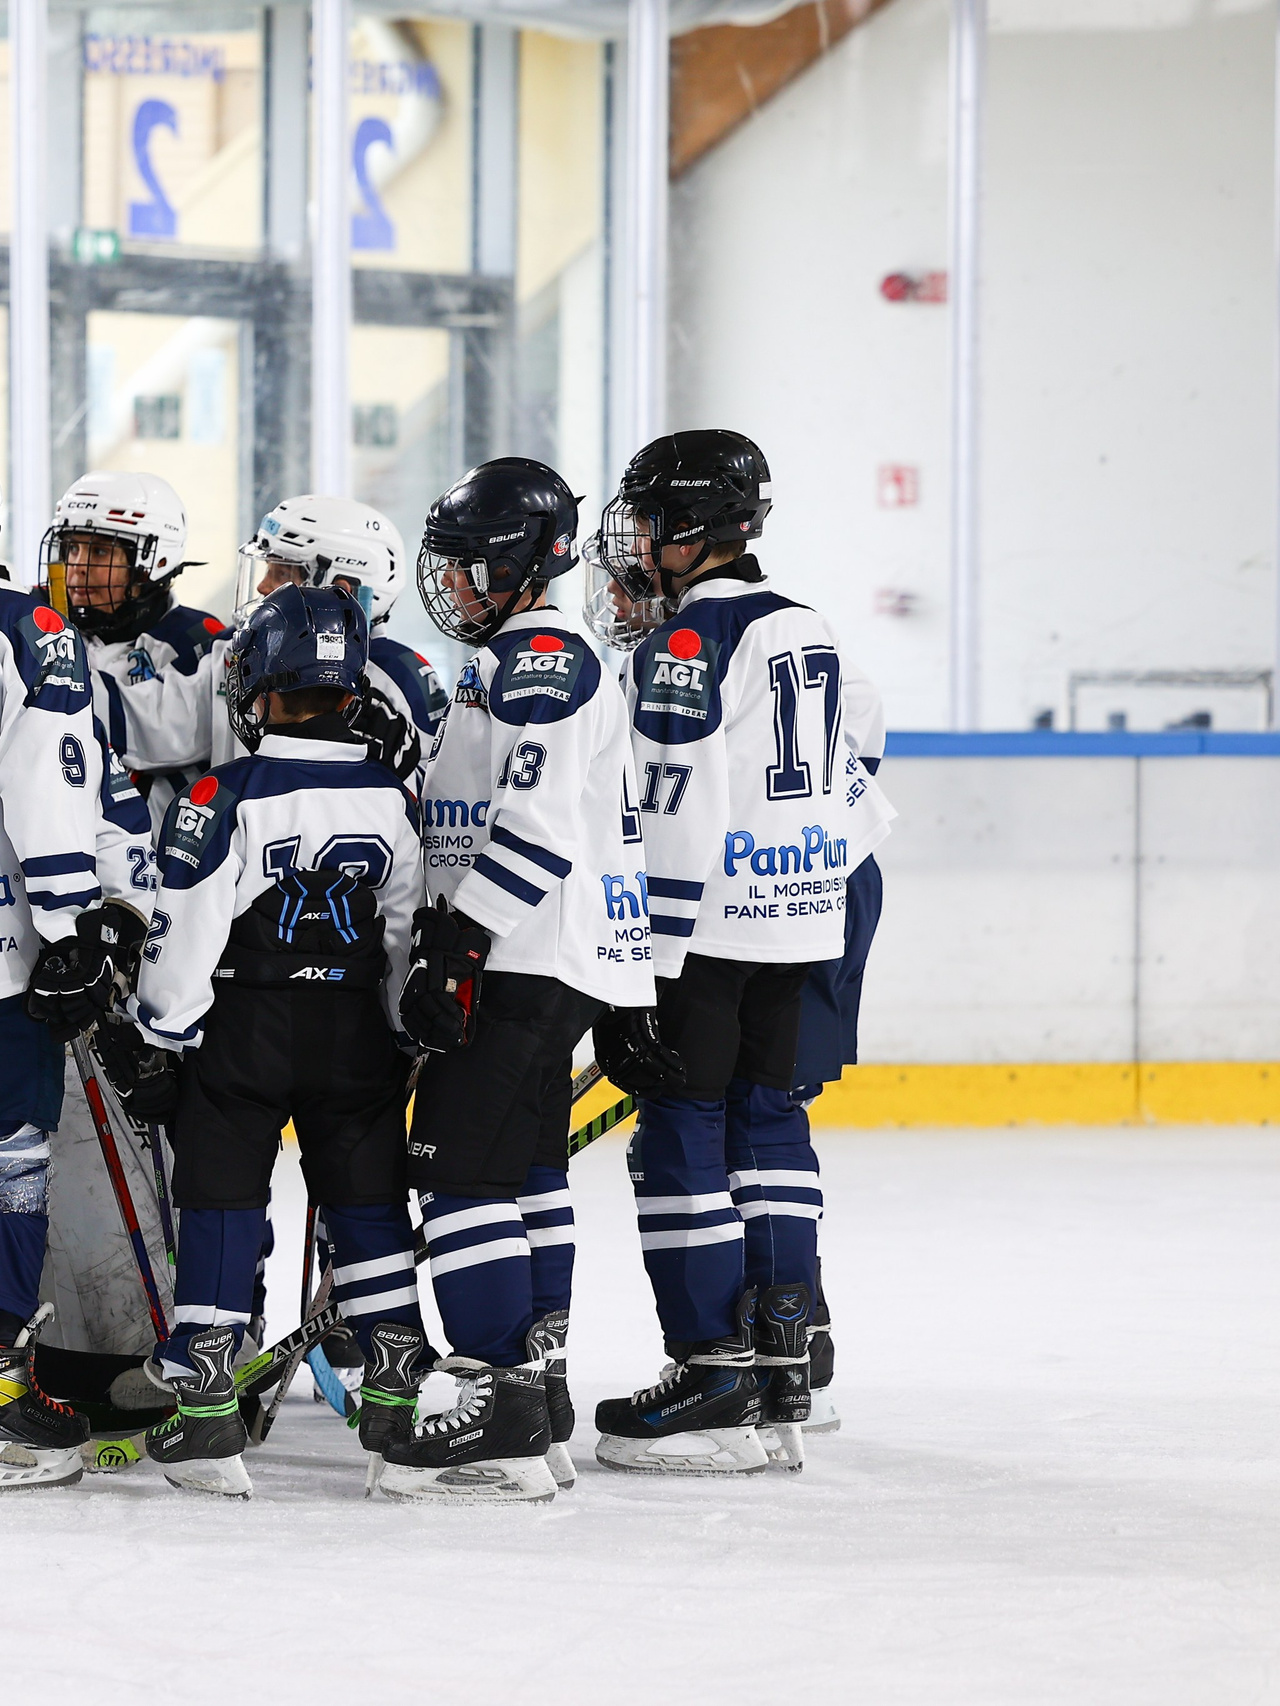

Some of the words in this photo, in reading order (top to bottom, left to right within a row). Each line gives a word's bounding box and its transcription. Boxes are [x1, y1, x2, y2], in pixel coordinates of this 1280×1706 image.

[67, 501, 99, 511] CCM
[163, 523, 180, 532] CCM
[334, 556, 368, 567] CCM
[512, 655, 570, 675] AGL
[652, 662, 704, 692] AGL
[546, 687, 570, 701] IDEAS
[681, 708, 707, 719] IDEAS
[766, 645, 843, 801] 17
[59, 732, 88, 788] 9
[639, 762, 693, 815] 17
[748, 884, 766, 900] IL
[299, 911, 331, 921] AX5
[724, 902, 781, 920] PANE
[786, 899, 834, 917] SENZA
[289, 966, 347, 981] AX5
